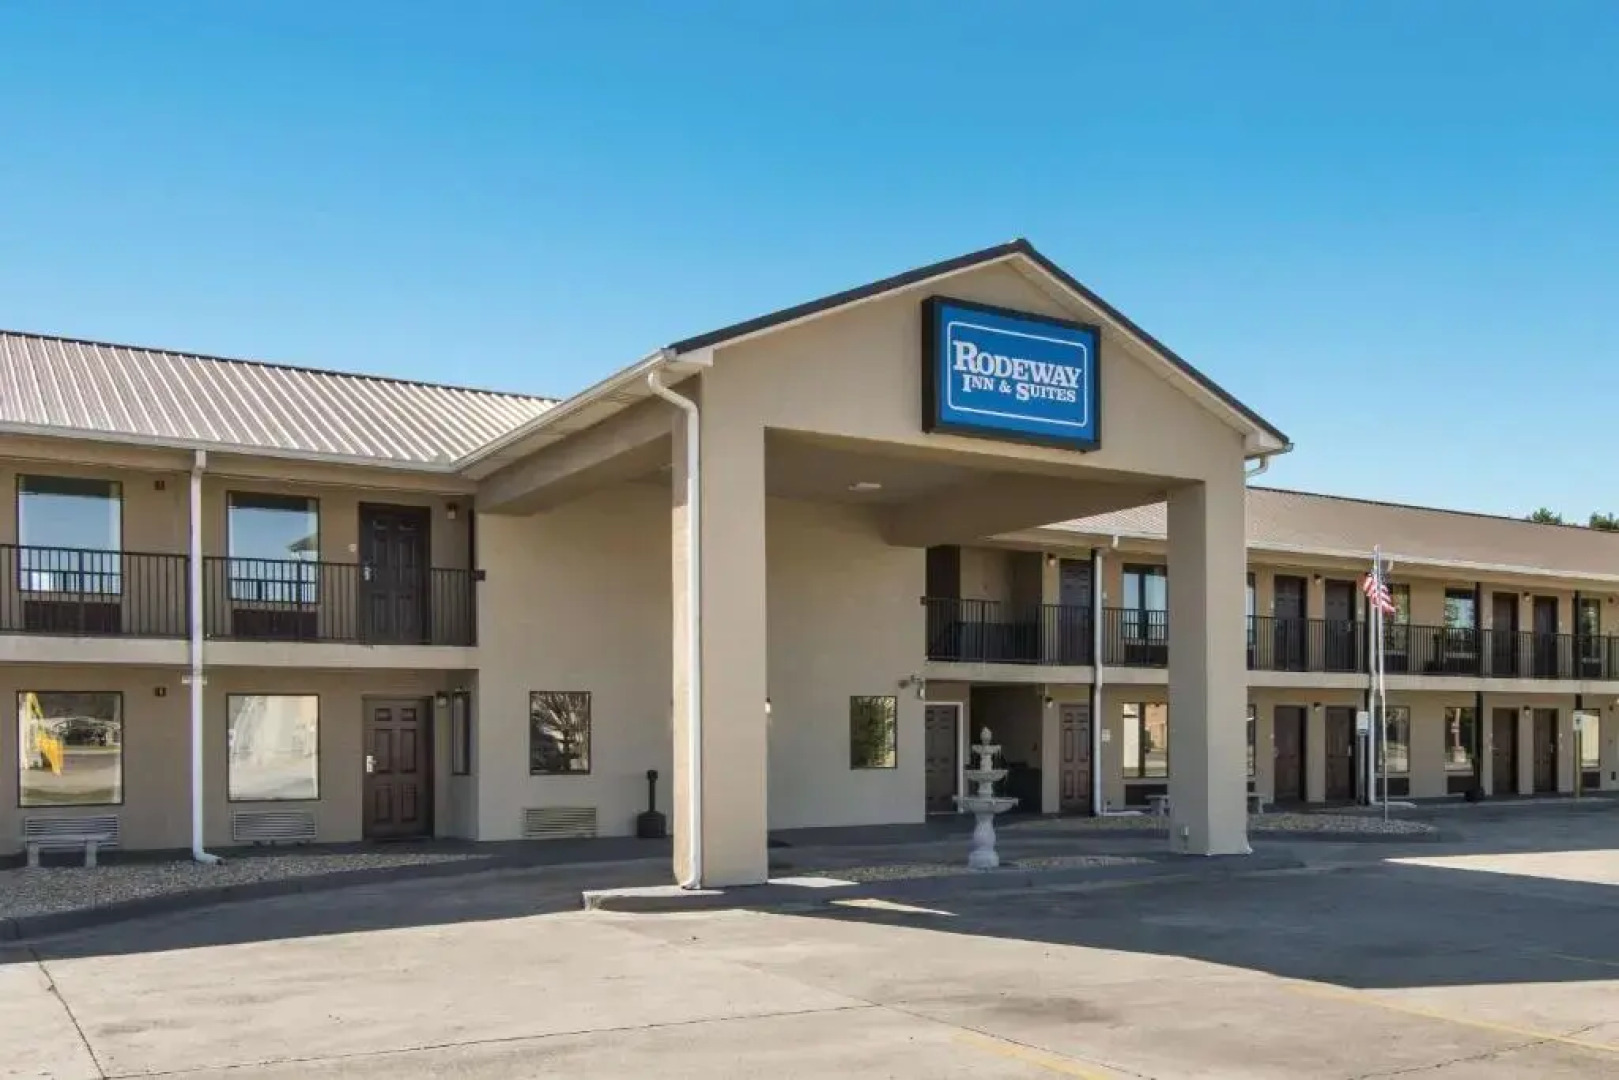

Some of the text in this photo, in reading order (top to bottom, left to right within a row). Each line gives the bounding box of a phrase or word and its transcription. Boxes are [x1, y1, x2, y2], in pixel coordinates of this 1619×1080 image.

[952, 340, 1082, 388] RODEWAY
[961, 374, 1076, 402] INN & SUITES
